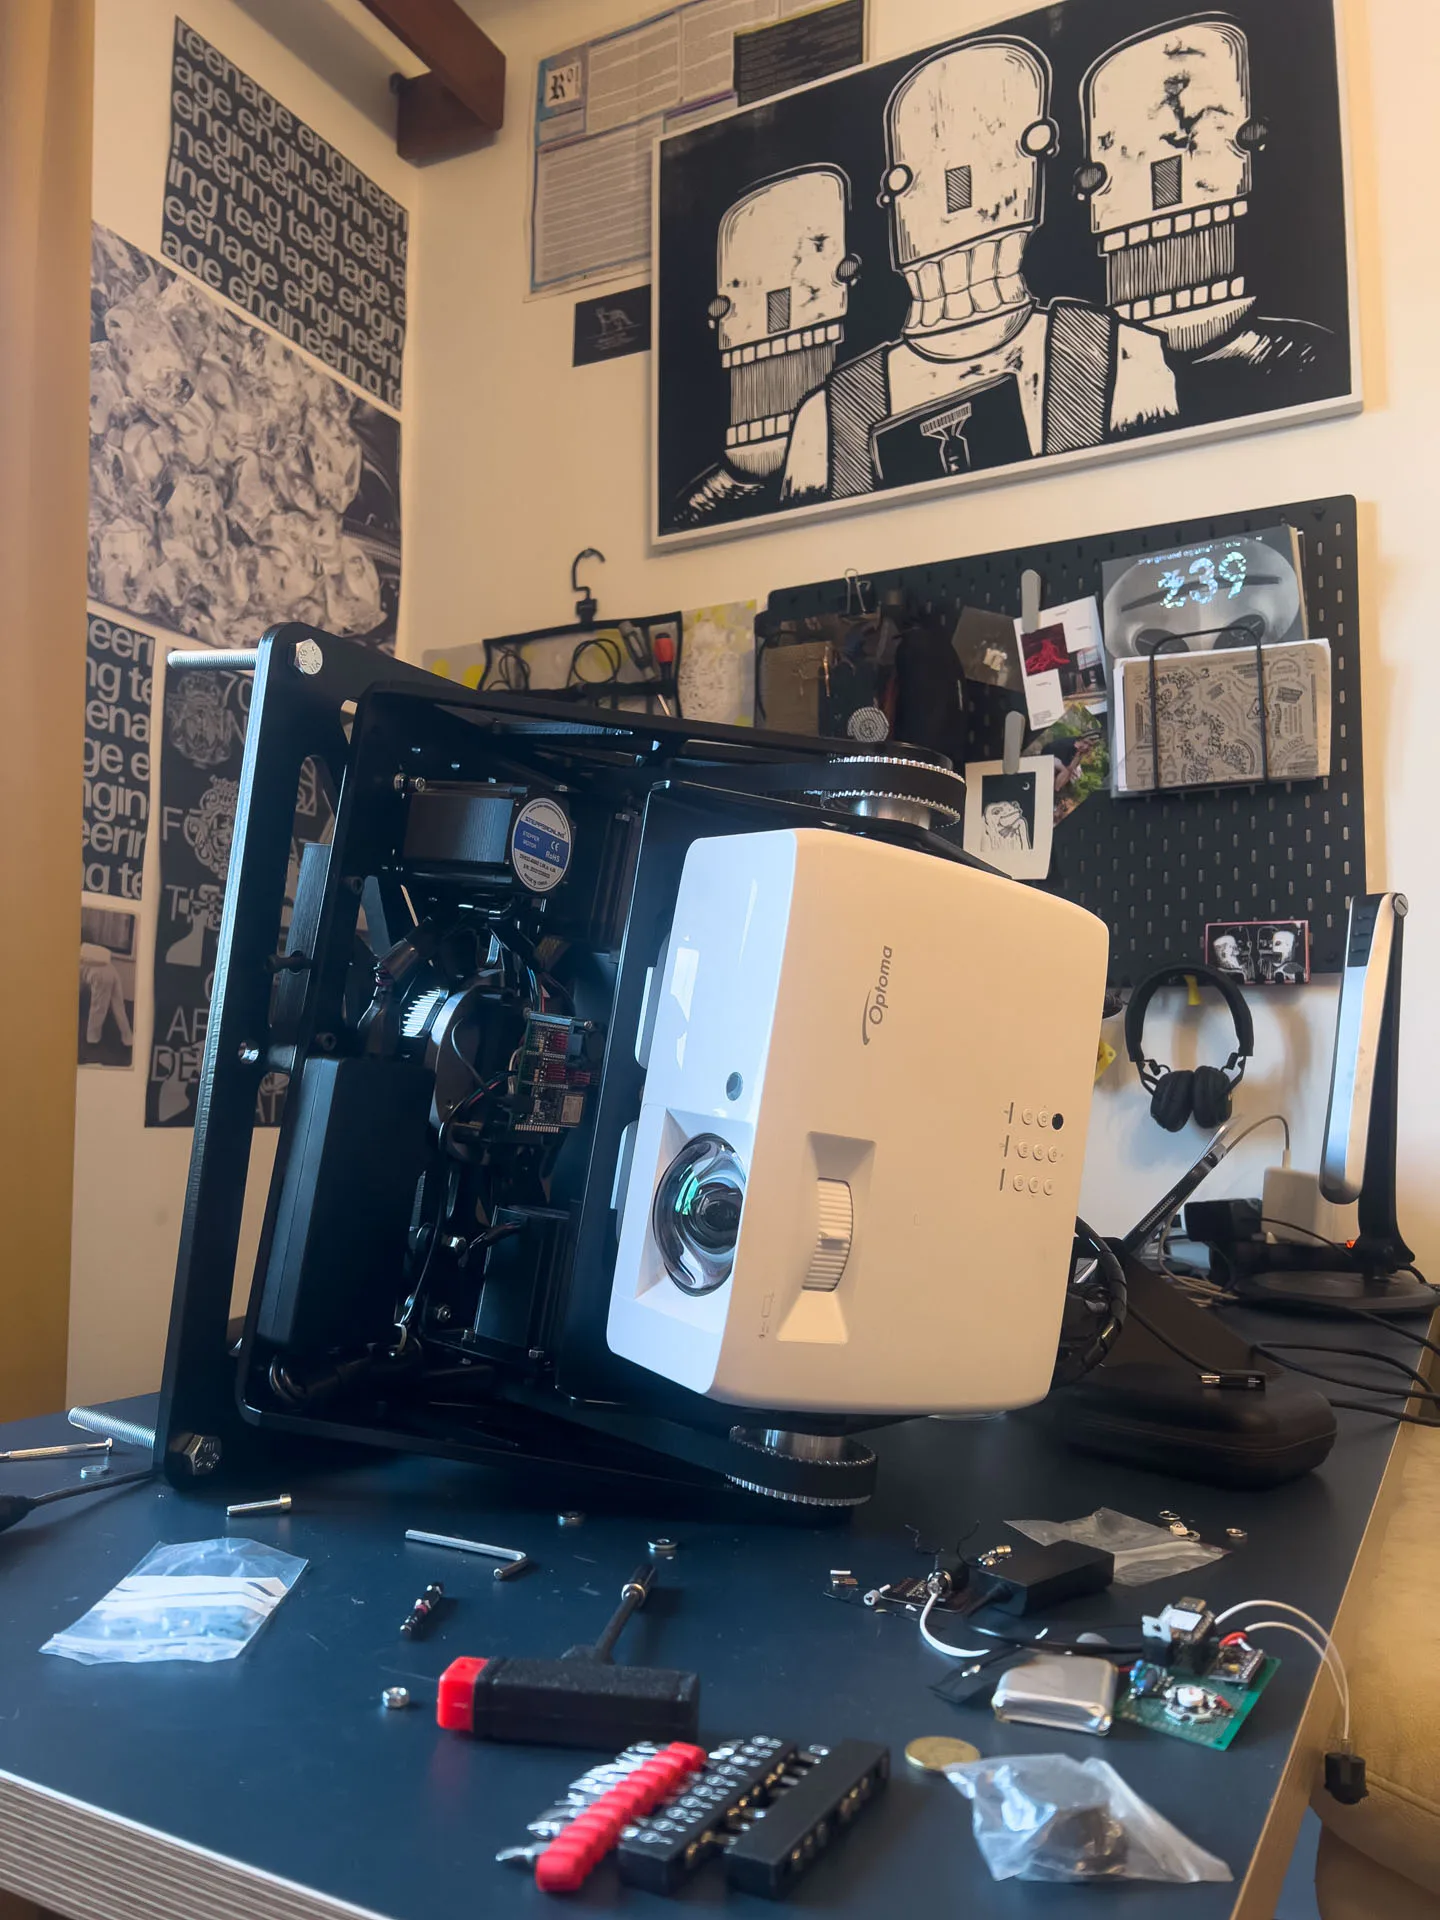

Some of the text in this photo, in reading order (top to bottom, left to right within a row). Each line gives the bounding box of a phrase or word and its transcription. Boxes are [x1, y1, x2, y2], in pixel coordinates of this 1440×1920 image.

[168, 147, 218, 218] ing
[224, 193, 334, 298] teenage
[173, 90, 336, 242] engineering
[173, 122, 282, 233] neering
[286, 209, 390, 306] teenage
[174, 56, 232, 117] age
[238, 107, 388, 251] engineering
[164, 195, 279, 290] eenage
[228, 276, 381, 397] engineering
[869, 945, 892, 1025] Optoma
